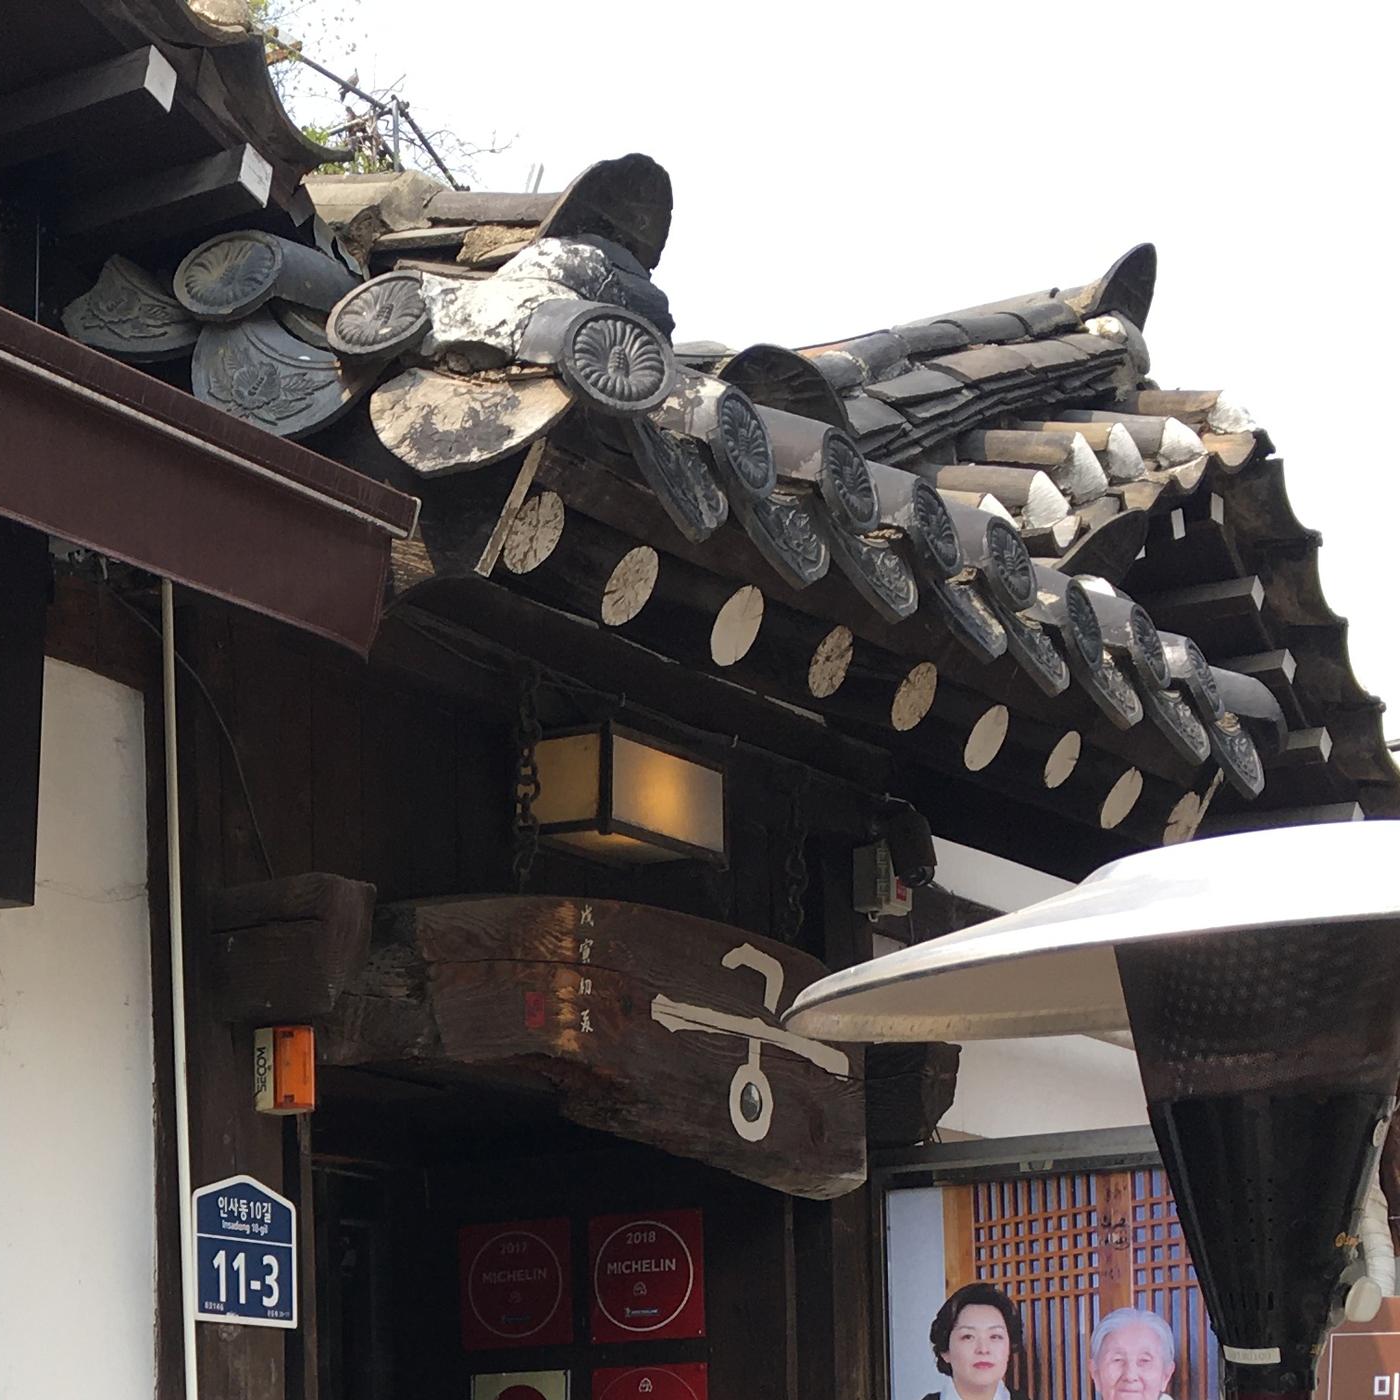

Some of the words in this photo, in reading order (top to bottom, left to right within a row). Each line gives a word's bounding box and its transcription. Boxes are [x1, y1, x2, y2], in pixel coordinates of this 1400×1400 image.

[254, 1046, 268, 1097] SECOM
[217, 1196, 272, 1223] 인사동10길
[626, 1231, 656, 1245] 2018
[482, 1268, 548, 1284] MICHELIN
[607, 1258, 677, 1275] MICHELIN
[212, 1249, 280, 1308] 11-3
